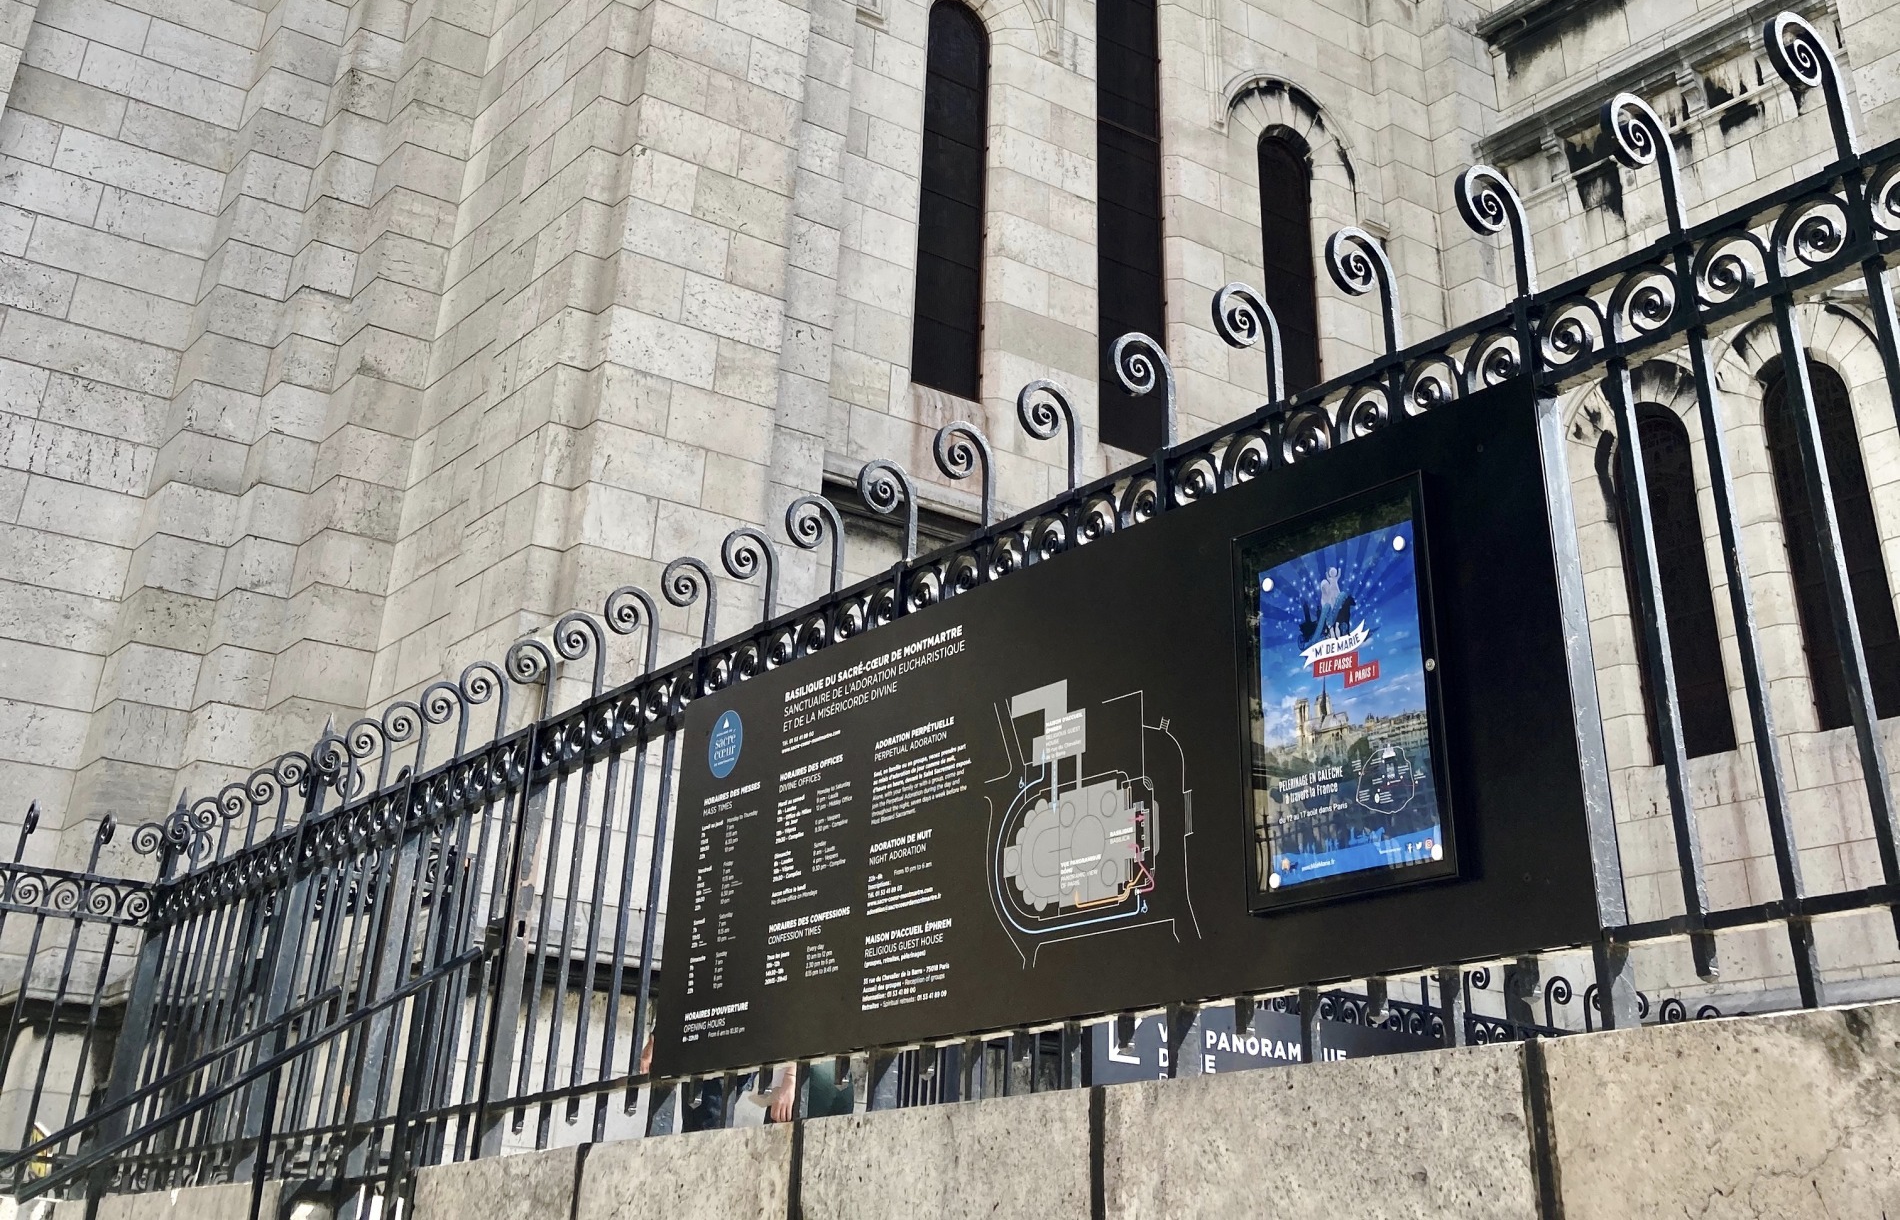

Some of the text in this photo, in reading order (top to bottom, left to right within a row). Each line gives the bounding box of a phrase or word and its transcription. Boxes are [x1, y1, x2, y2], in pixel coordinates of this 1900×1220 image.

[1326, 644, 1335, 654] DE
[1337, 633, 1360, 651] MARIE
[785, 679, 824, 702] BASILIQUE
[825, 674, 836, 685] DU
[891, 649, 902, 662] DE
[904, 625, 963, 657] MONTMARTRE
[1319, 656, 1353, 674] ELLE PASSE
[784, 640, 965, 717] SANCTUAIRE DE L'ADORATION EUCHARISTIQUE
[1355, 668, 1371, 682] PARIS
[783, 682, 898, 732] ET DE LA MISÉRICORDE DIVINE
[875, 716, 954, 750] ADORATION PERPÉTUELLE
[875, 731, 947, 762] PERPETUAL ADORATION
[780, 754, 843, 781] HORAIRES DES OFFICES
[1309, 772, 1316, 784] EN
[704, 781, 761, 806] HORAIRES DES MESSES
[779, 773, 821, 793] DIVINE OFFICES
[1290, 789, 1309, 803] travers
[1310, 787, 1315, 797] la
[1317, 782, 1338, 796] France
[703, 801, 732, 817] MASS TIMES
[1333, 803, 1348, 811] Paris
[870, 829, 932, 854] ADORATION DE NUIT
[869, 843, 926, 866] NIGHT ADORATION
[894, 868, 904, 876] From
[769, 906, 850, 933] HORAIRES DES CONFESSIONS
[768, 925, 821, 945] CONFESSION TIMES
[865, 918, 952, 945] MAISON D'ACCUEIL ÉPHREM
[865, 933, 943, 958] RELIGIOUS GUEST HOUSE
[685, 1002, 748, 1021] HORAIRES D'OUVERTURE
[684, 1018, 725, 1033] OPENING HOURS
